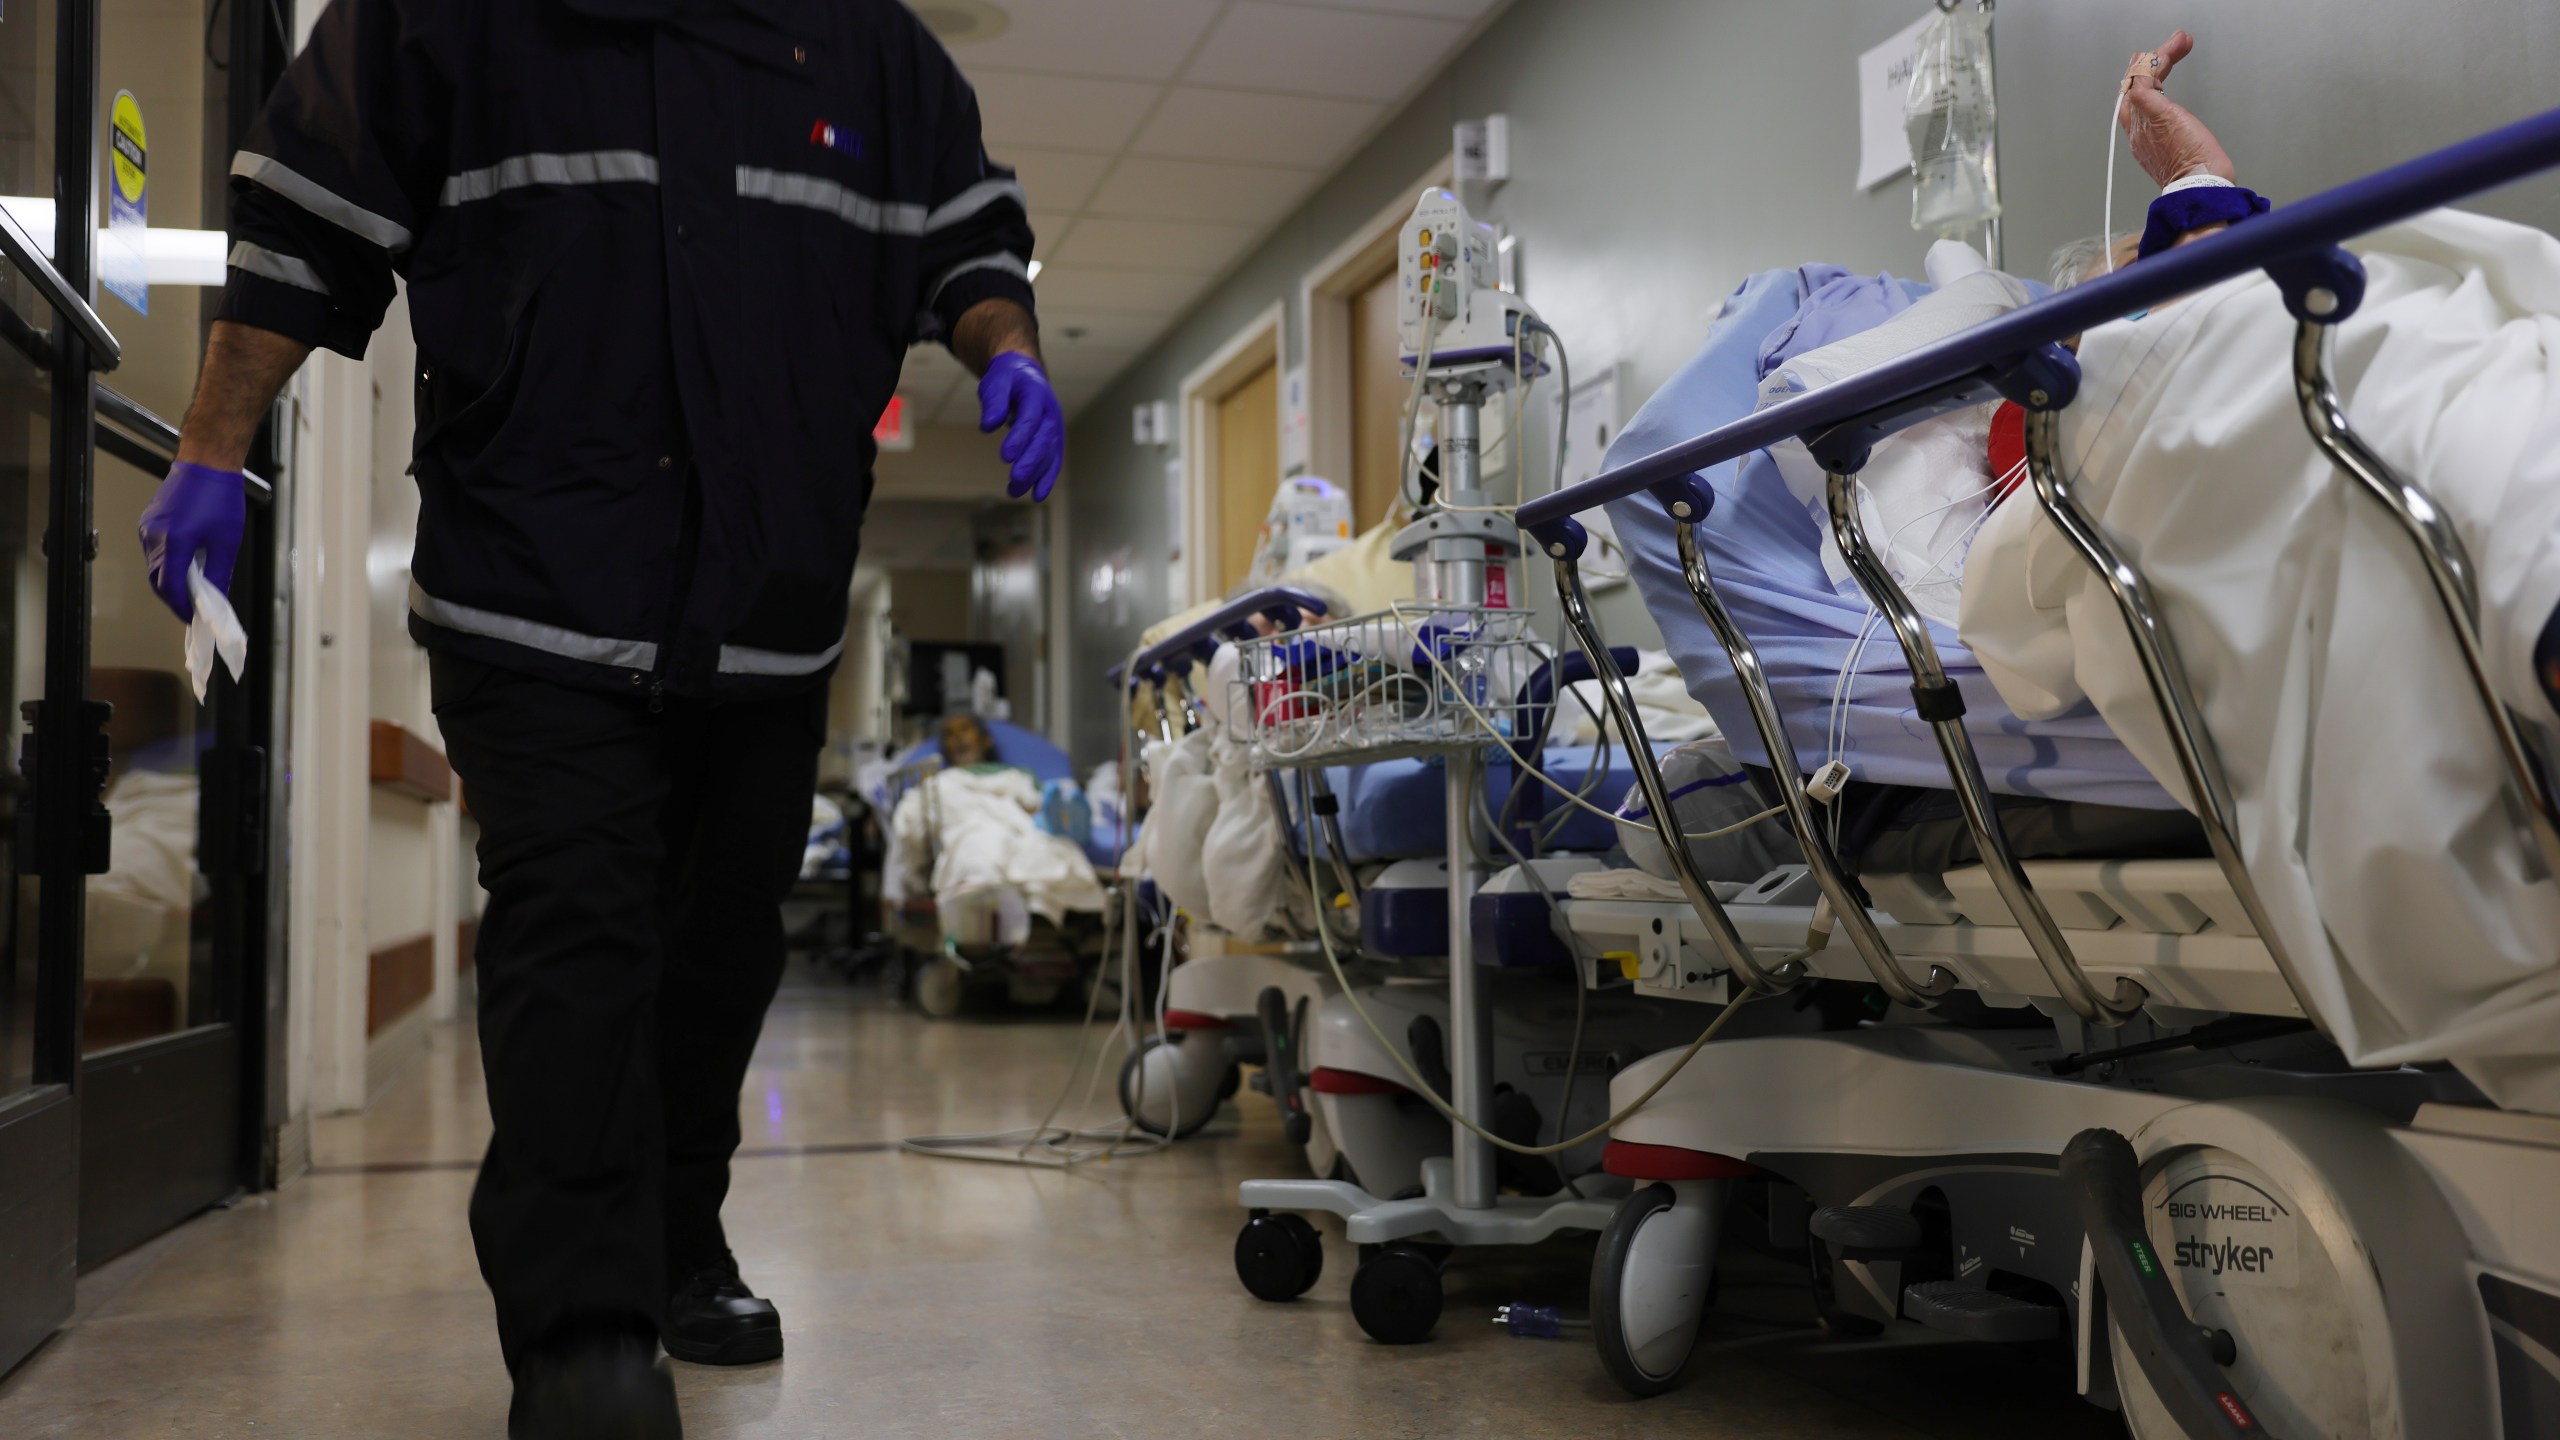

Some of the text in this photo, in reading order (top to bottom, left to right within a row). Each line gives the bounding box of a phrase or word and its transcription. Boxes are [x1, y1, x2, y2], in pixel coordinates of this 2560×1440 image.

[2168, 1202, 2196, 1218] BIG
[2133, 1242, 2152, 1273] STEER
[2173, 1234, 2274, 1275] stryker
